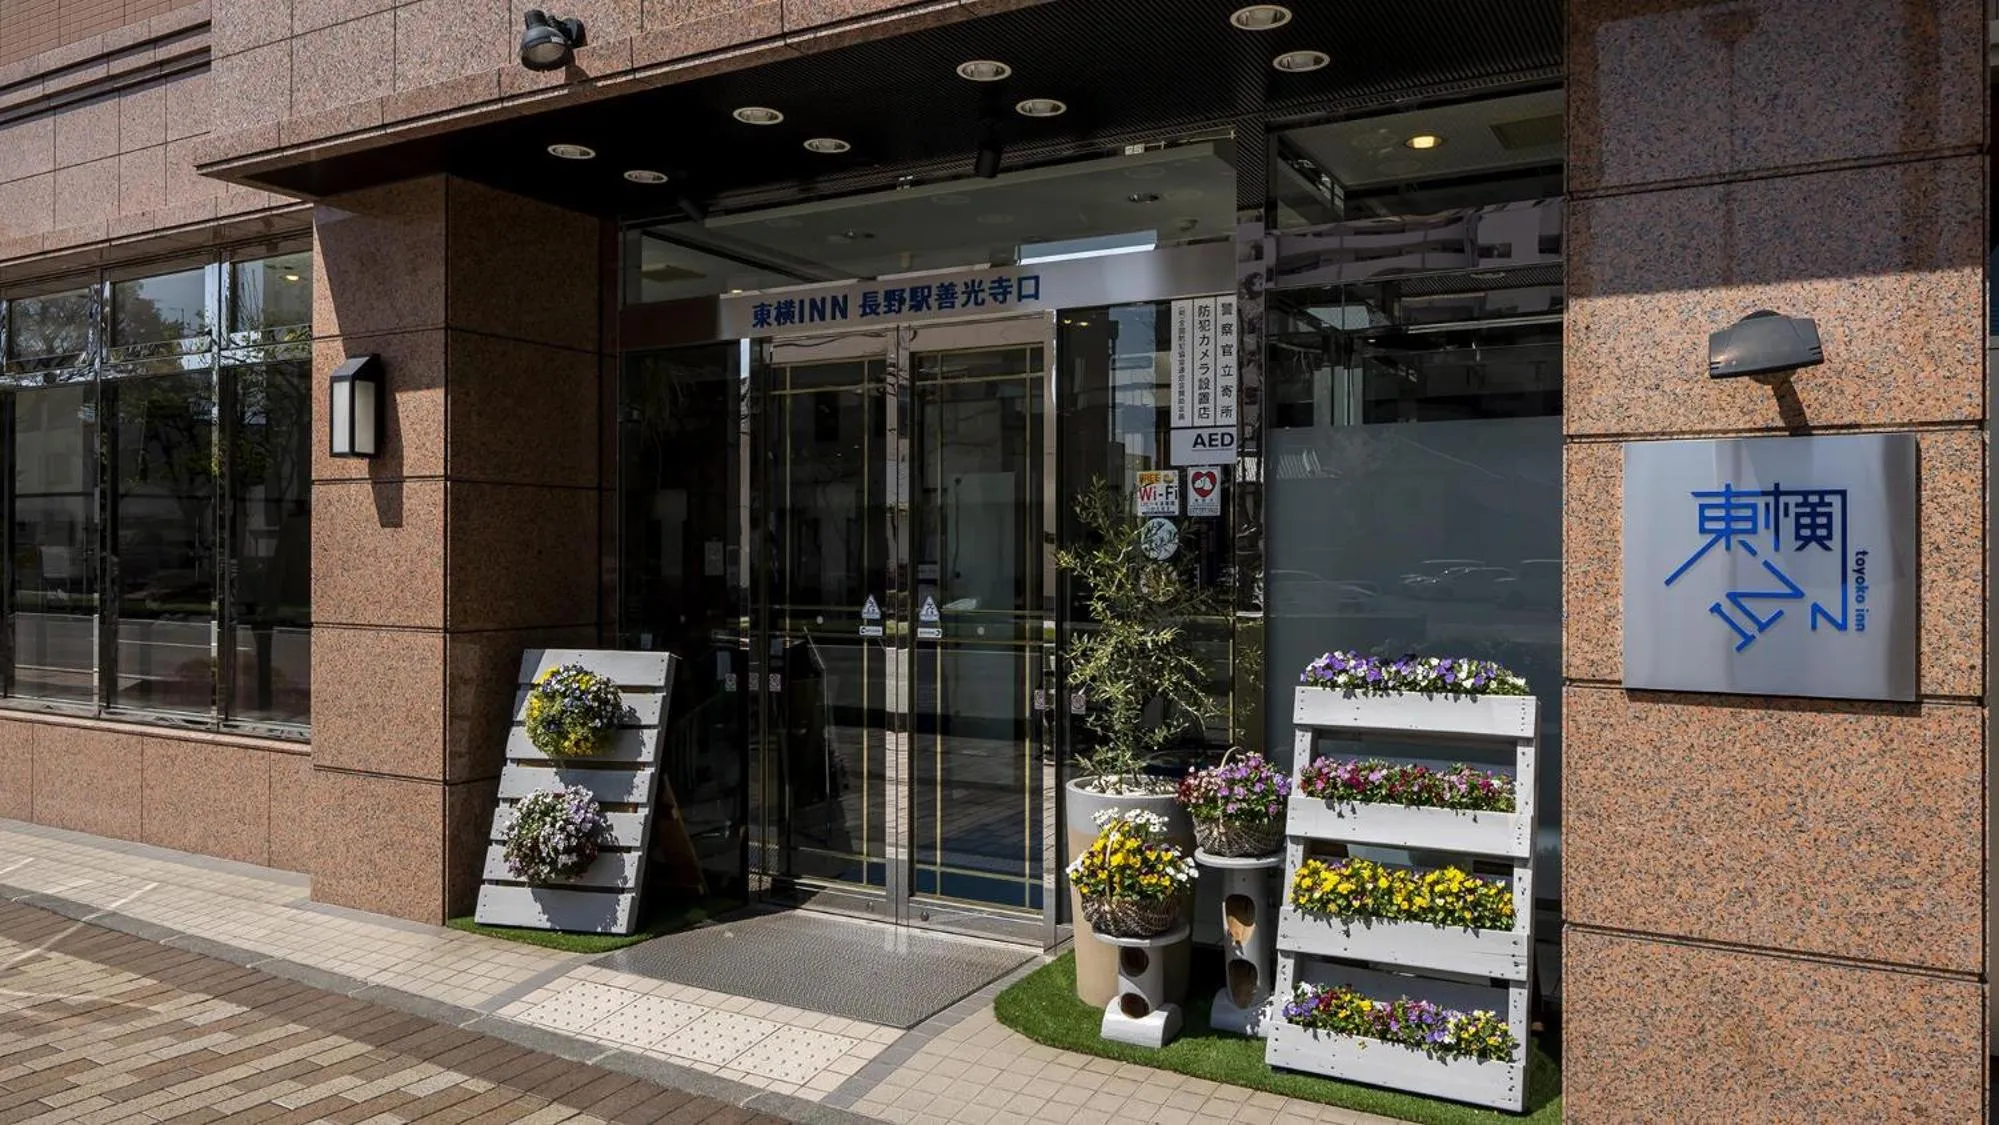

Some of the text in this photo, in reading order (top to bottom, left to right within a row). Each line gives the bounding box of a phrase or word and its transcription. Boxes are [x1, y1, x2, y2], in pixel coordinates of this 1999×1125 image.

[752, 275, 1041, 328] 東横INN 長野駅善光寺口
[1197, 304, 1211, 420] 防犯カメラ設置店
[1220, 303, 1234, 418] 警察官立寄所
[1192, 432, 1235, 449] AED
[1138, 486, 1178, 502] Wi-Fi
[1852, 549, 1869, 632] toyoko inn
